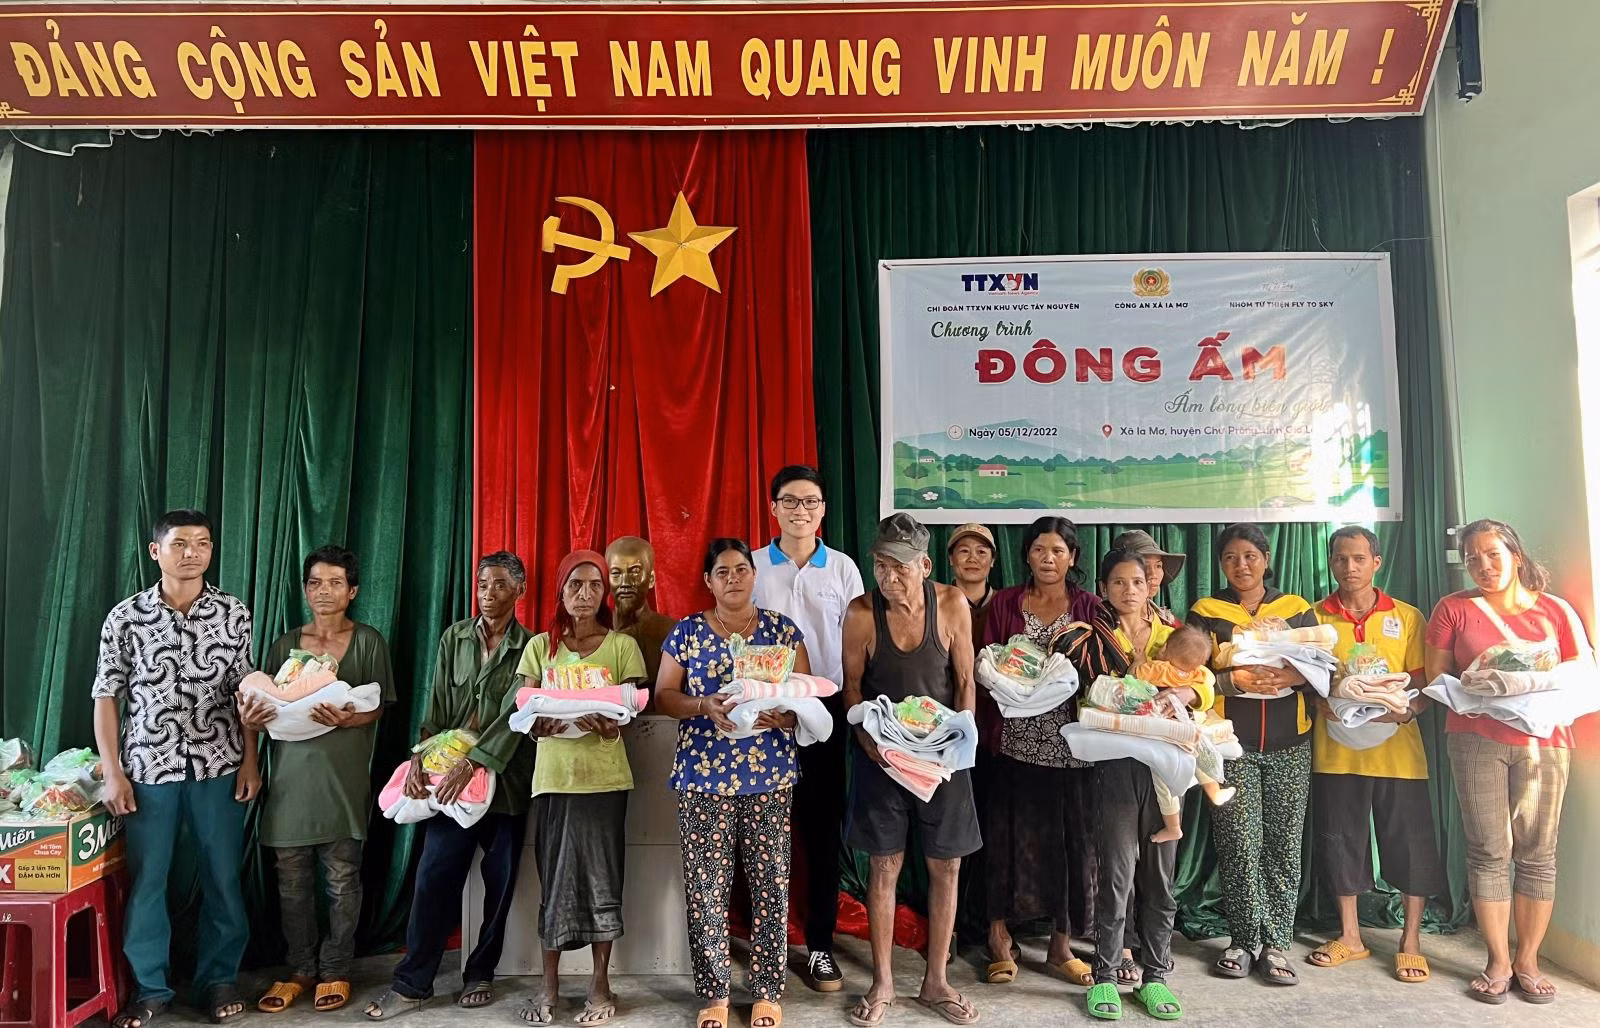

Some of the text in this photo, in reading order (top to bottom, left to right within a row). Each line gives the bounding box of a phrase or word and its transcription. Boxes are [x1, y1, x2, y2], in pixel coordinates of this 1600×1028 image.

[9, 12, 1394, 114] ĐẢNG CỘNG SẢN VIỆT NAM QUANG VINH MUÔN NĂM !
[961, 273, 1039, 292] TTXVN
[942, 304, 964, 312] ĐOÀN
[930, 319, 1033, 342] Chương trình
[974, 331, 1288, 384] ĐÔNG ẤM
[1164, 388, 1205, 414] Ấm
[969, 427, 1058, 439] Ngày 05/12/2022
[1120, 426, 1134, 436] Xã
[1149, 426, 1168, 437] Mơ,
[1170, 426, 1201, 438] huyện
[1203, 425, 1226, 436] Chư
